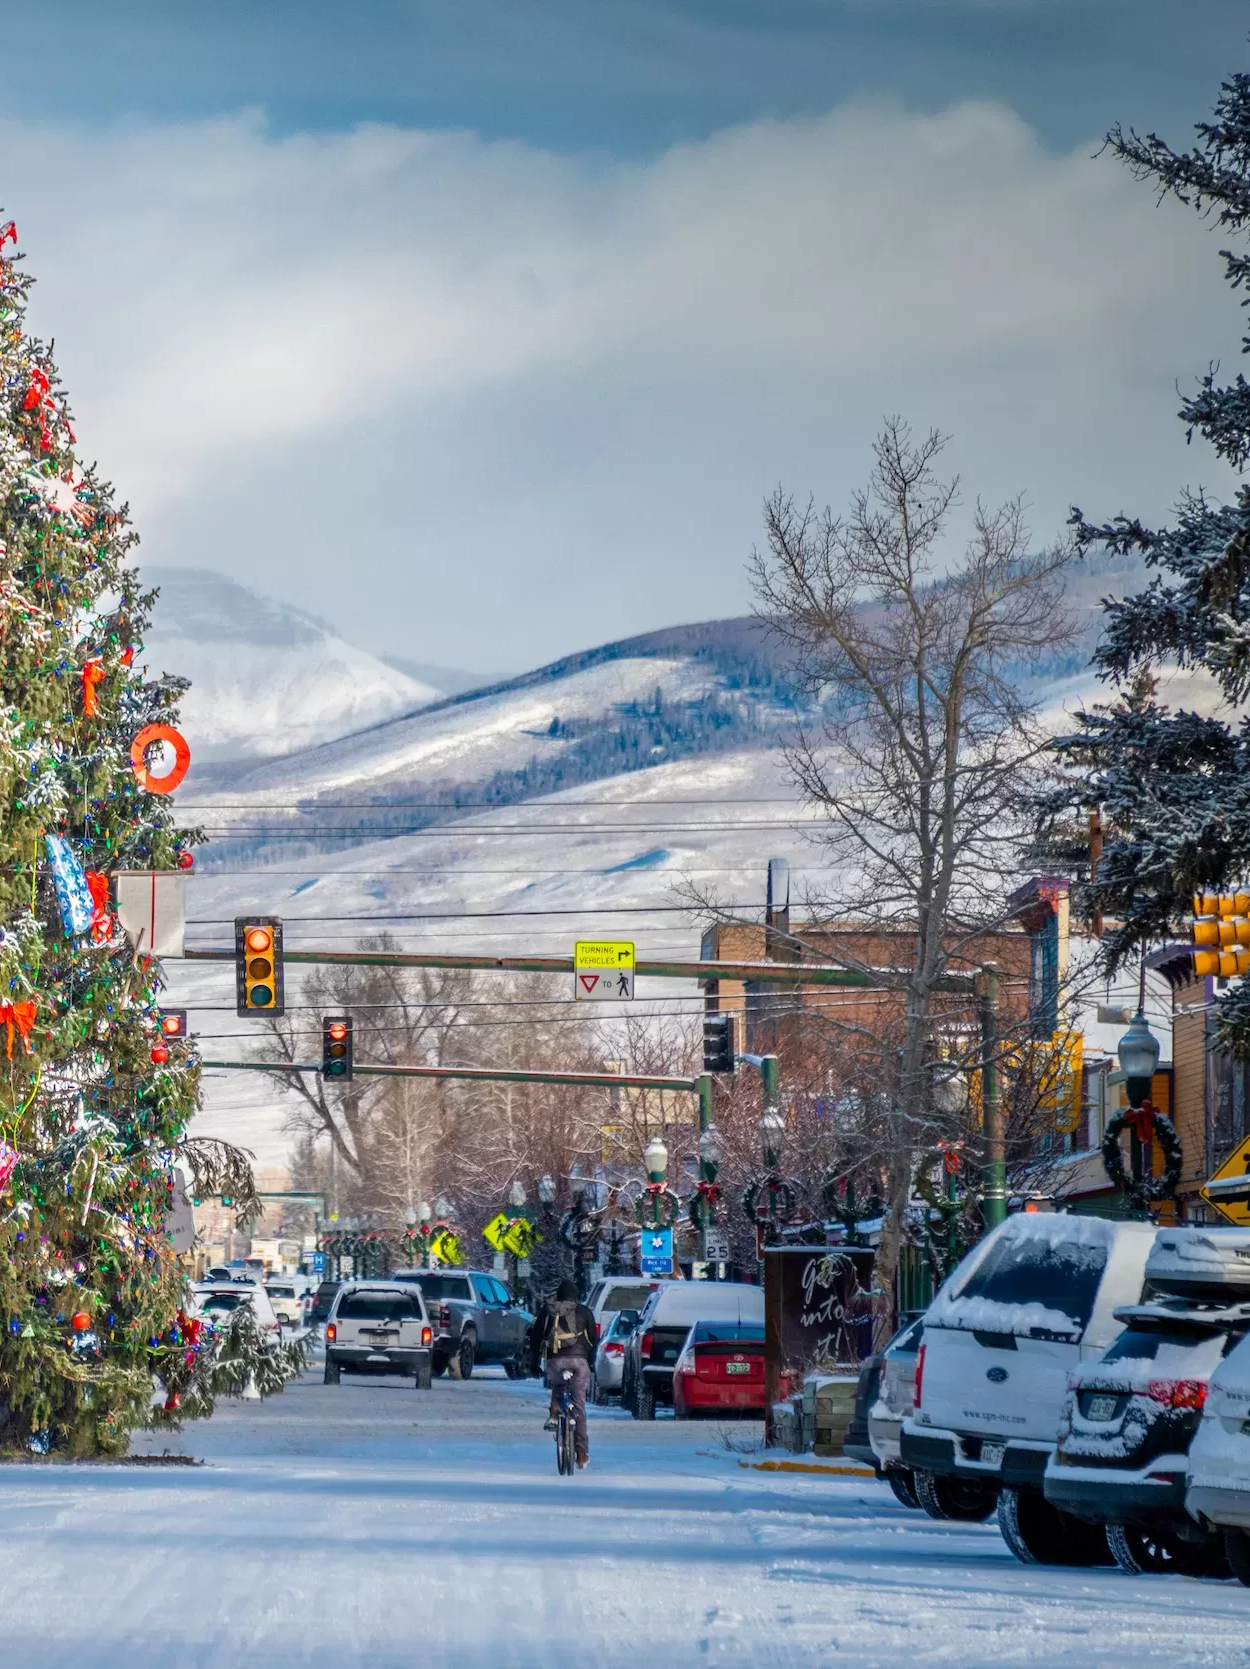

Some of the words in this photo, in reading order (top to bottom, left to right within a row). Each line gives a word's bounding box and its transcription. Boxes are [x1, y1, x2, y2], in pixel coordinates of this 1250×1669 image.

[581, 946, 614, 954] TURNING
[579, 957, 615, 965] VEHICLES
[602, 980, 612, 988] TO
[706, 1246, 728, 1258] 25
[315, 1256, 323, 1265] H
[800, 1294, 844, 1328] into
[813, 1327, 842, 1361] it!
[963, 1409, 1027, 1424] www.sgm-inc.com
